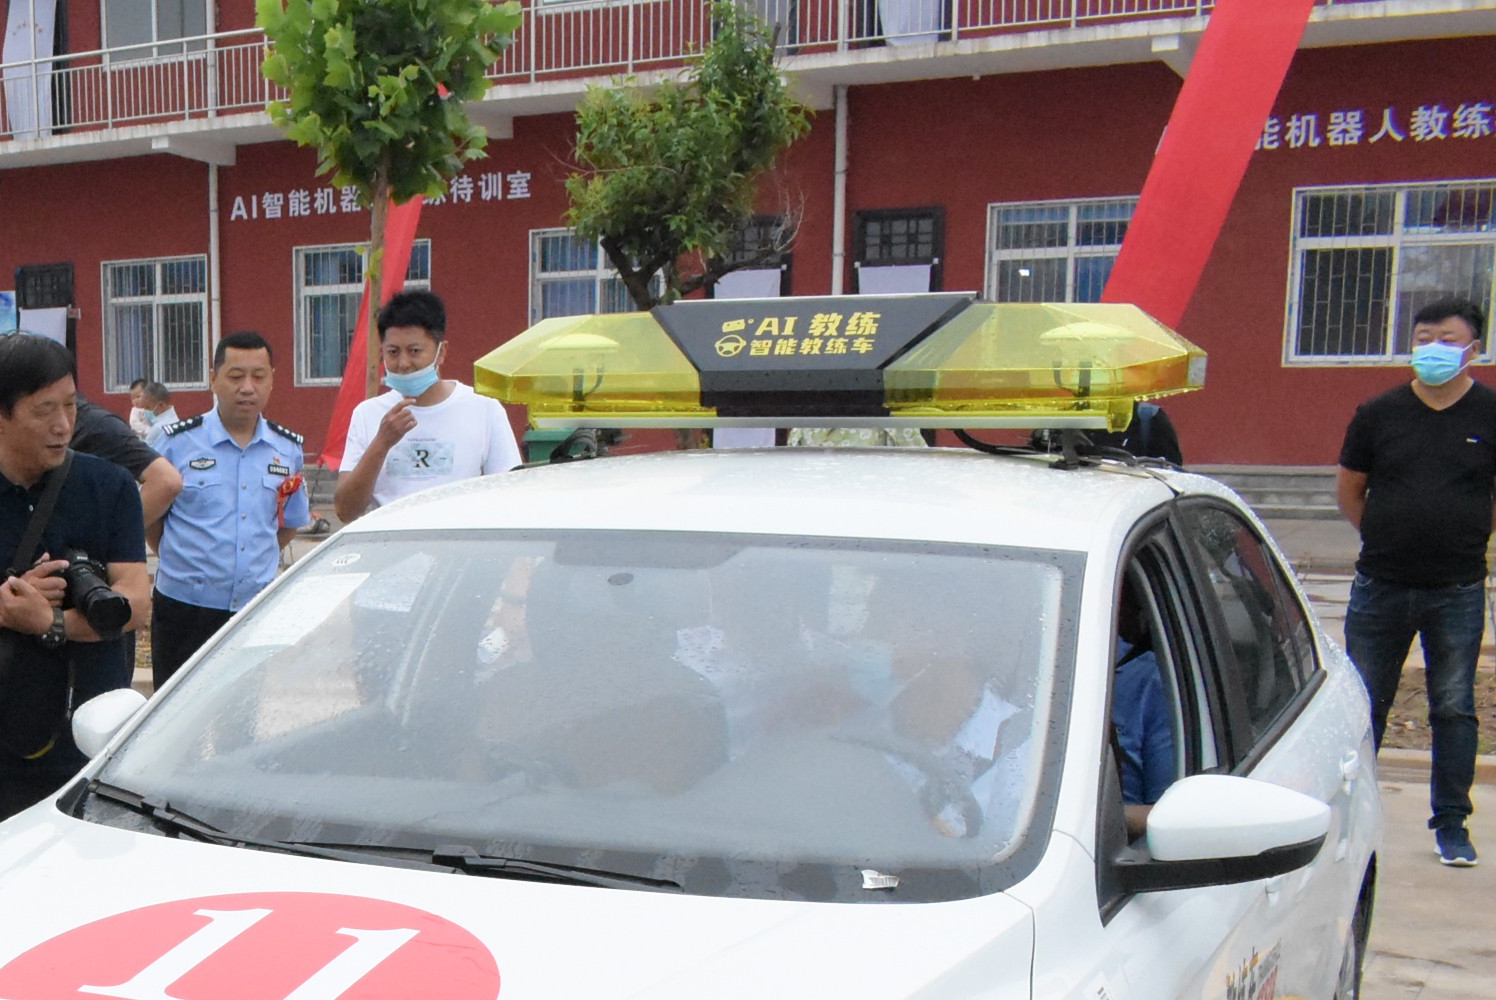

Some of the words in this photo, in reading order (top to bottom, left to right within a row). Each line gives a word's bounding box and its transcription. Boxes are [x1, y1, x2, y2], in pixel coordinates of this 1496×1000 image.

[230, 170, 532, 221] AI智能机器待训室
[749, 337, 875, 356] 智能教练车
